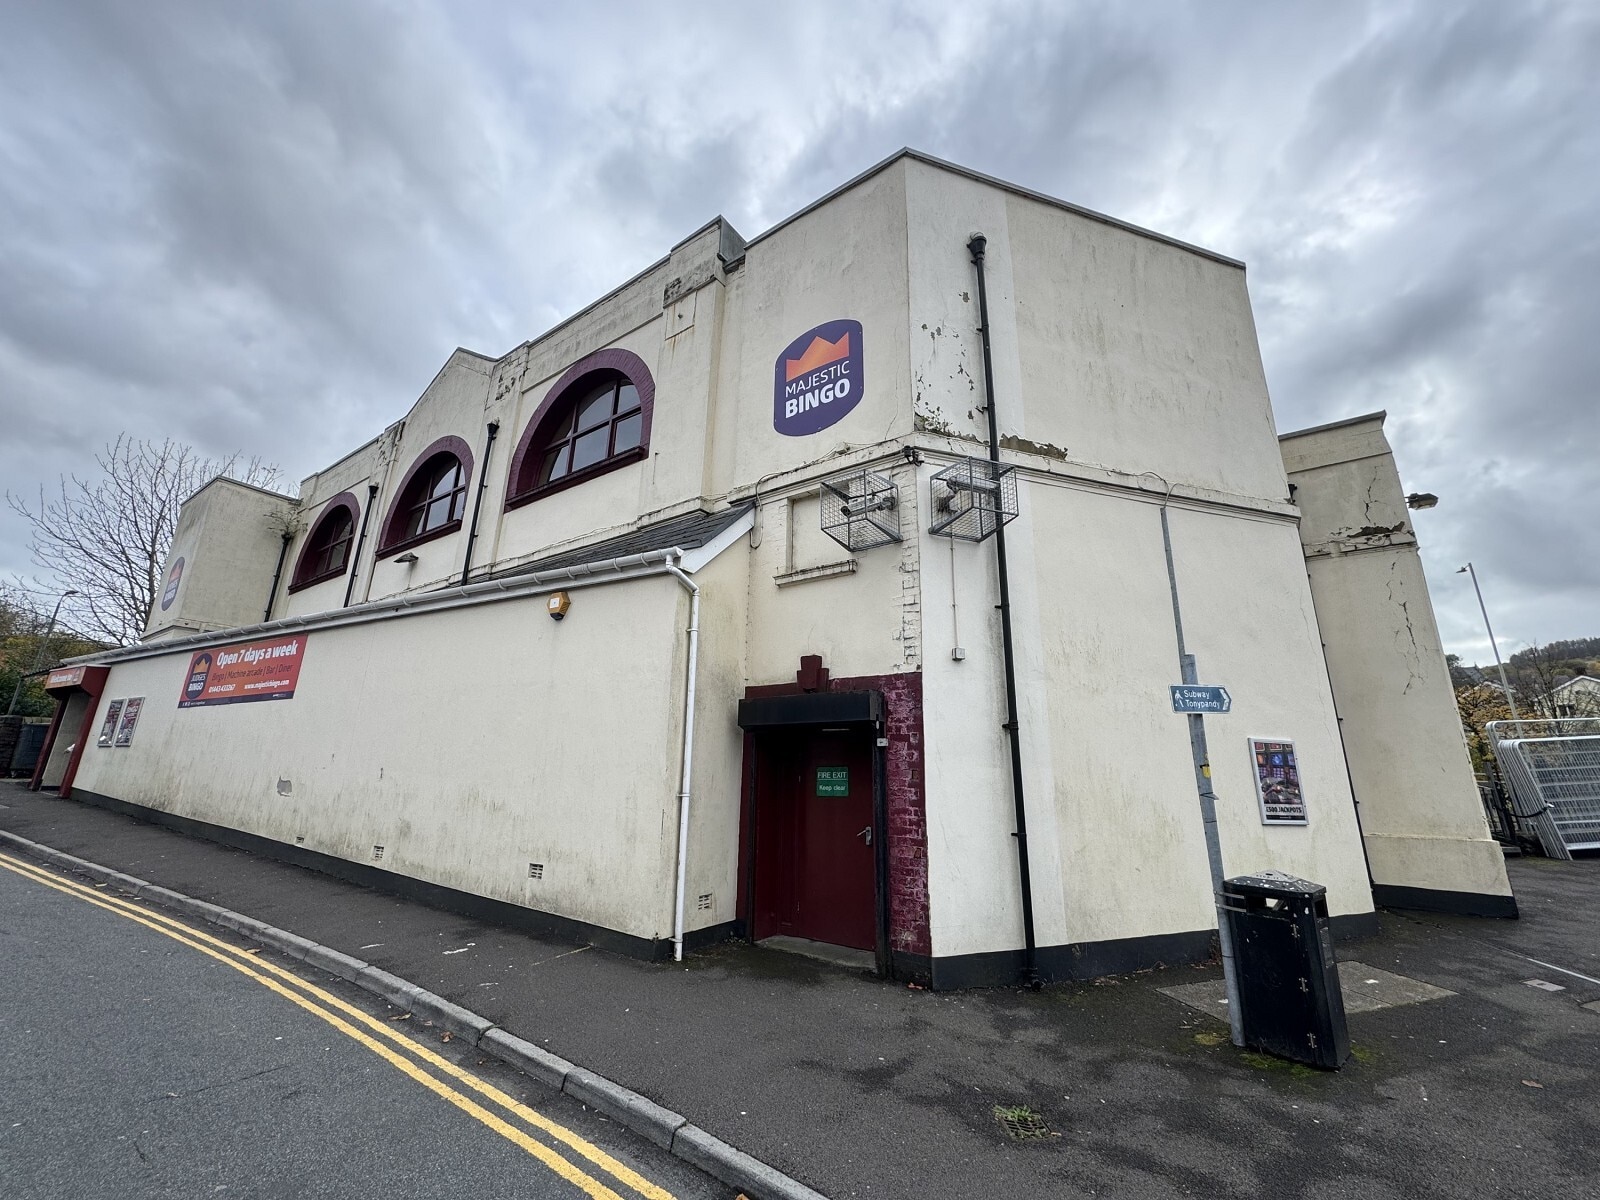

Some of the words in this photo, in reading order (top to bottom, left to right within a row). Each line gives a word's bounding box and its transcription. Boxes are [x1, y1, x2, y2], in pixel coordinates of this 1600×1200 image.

[785, 360, 850, 398] MAJESTIC
[785, 378, 851, 418] BINGO
[216, 651, 239, 669] Open
[238, 649, 245, 663] 7
[244, 647, 266, 665] days
[265, 646, 272, 658] a
[272, 640, 298, 658] week
[212, 673, 225, 683] Bingo
[228, 669, 247, 679] Machine
[246, 667, 263, 677] arcade
[266, 665, 276, 675] Bar
[278, 663, 294, 673] Diner
[187, 682, 204, 691] BINGO
[1183, 689, 1210, 700] Subway
[1185, 699, 1220, 709] Tonypandy
[817, 771, 831, 779] FIRE
[832, 771, 847, 779] EXIT
[819, 784, 832, 792] Keep
